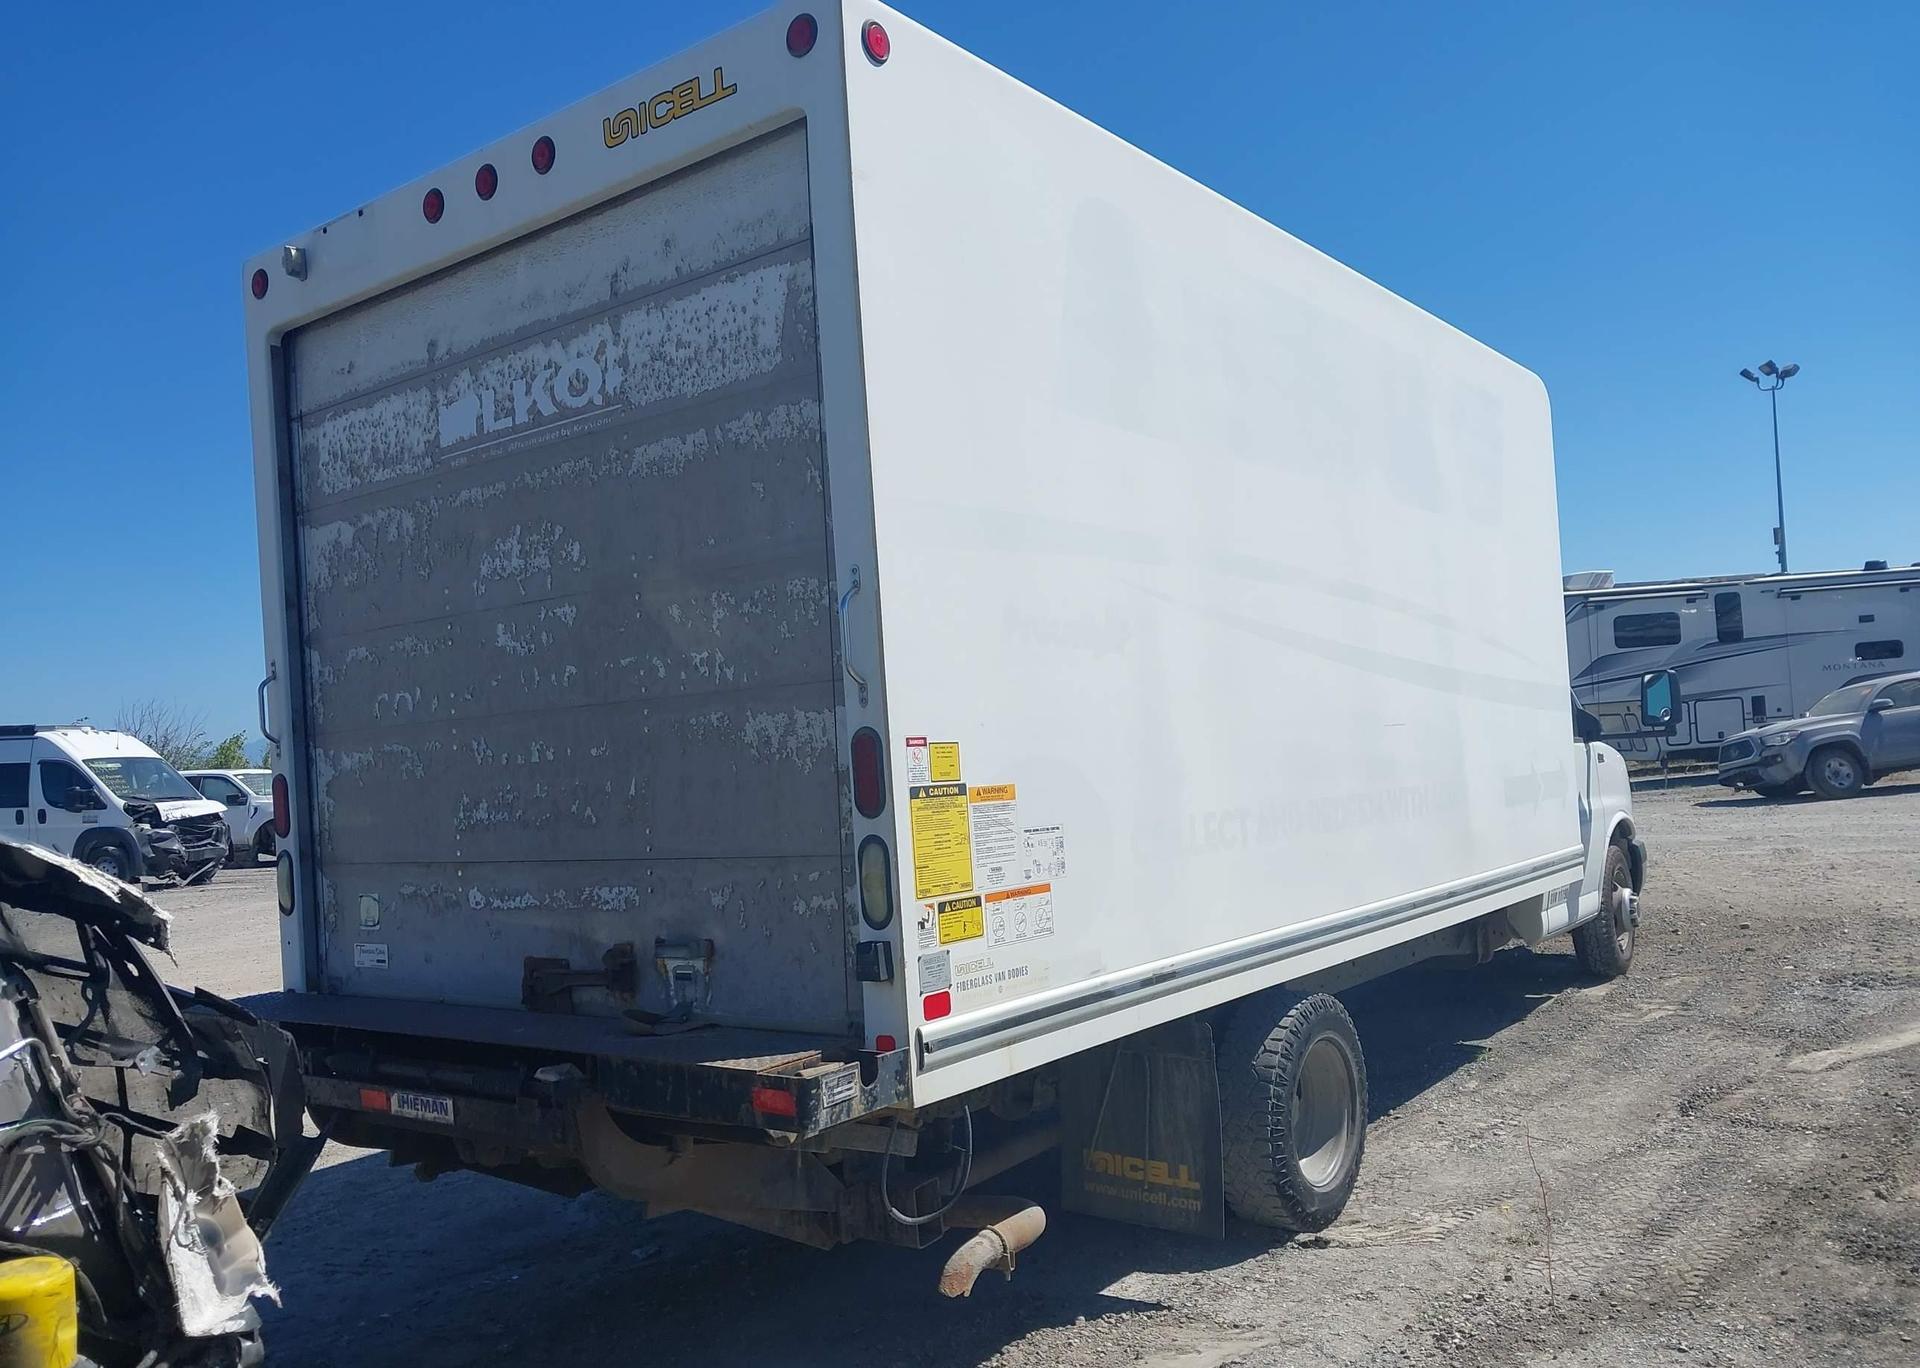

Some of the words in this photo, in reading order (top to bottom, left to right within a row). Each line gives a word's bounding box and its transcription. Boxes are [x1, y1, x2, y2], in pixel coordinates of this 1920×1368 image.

[602, 66, 738, 149] UNICELL
[1822, 661, 1886, 672] MONTANA
[928, 786, 959, 796] CAUTION
[981, 786, 1008, 796] WARNING
[951, 899, 977, 911] CAUTION
[956, 974, 993, 993] FIBERGLASS
[994, 970, 1006, 982] VAN
[1007, 965, 1029, 980] BODIES
